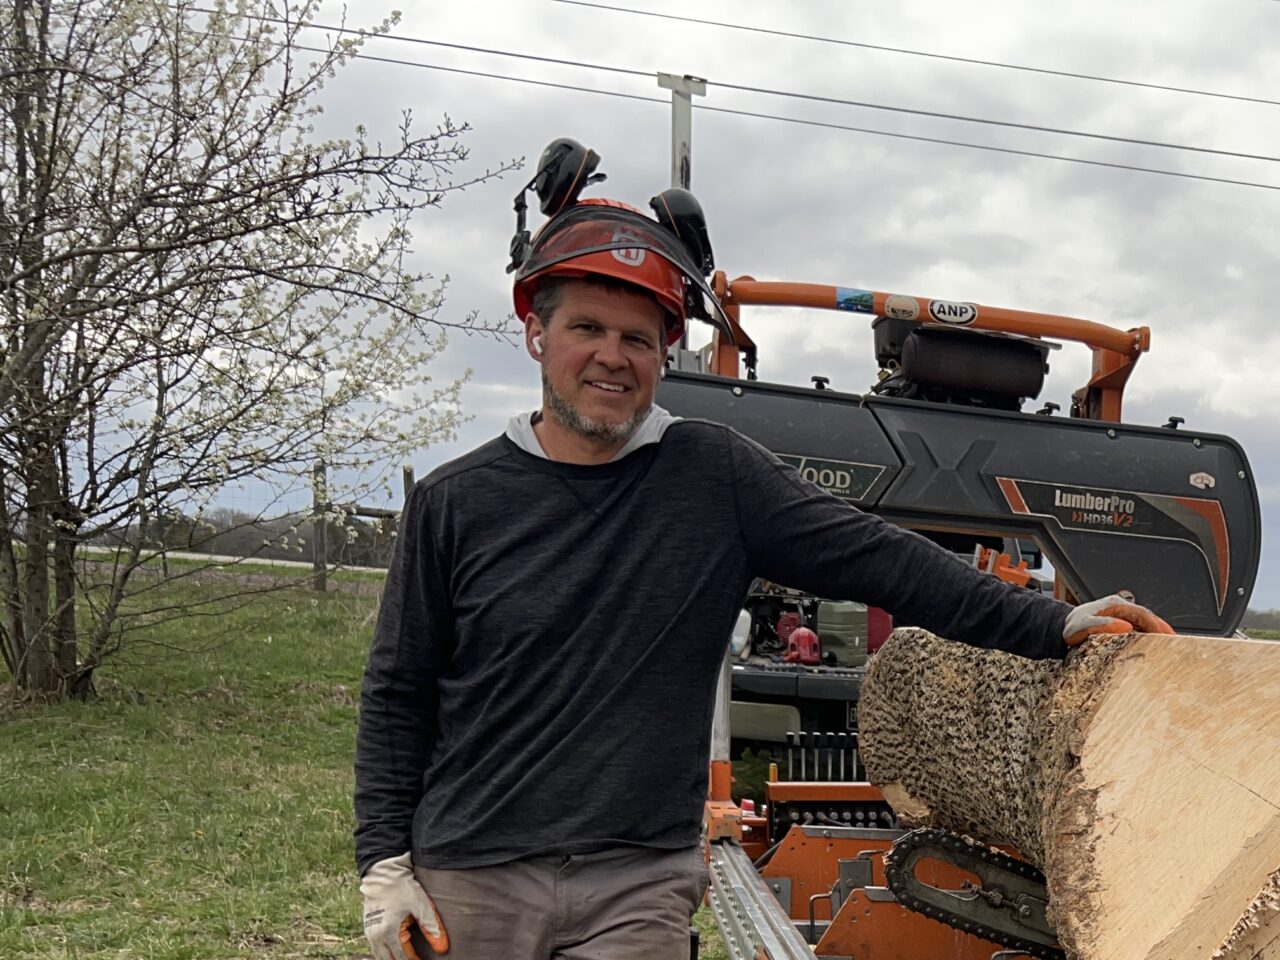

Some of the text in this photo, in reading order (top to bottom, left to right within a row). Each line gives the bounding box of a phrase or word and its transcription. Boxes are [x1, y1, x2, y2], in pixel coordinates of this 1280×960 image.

[936, 303, 969, 318] ANP
[801, 465, 851, 488] OOD
[1054, 489, 1135, 514] LumberPro
